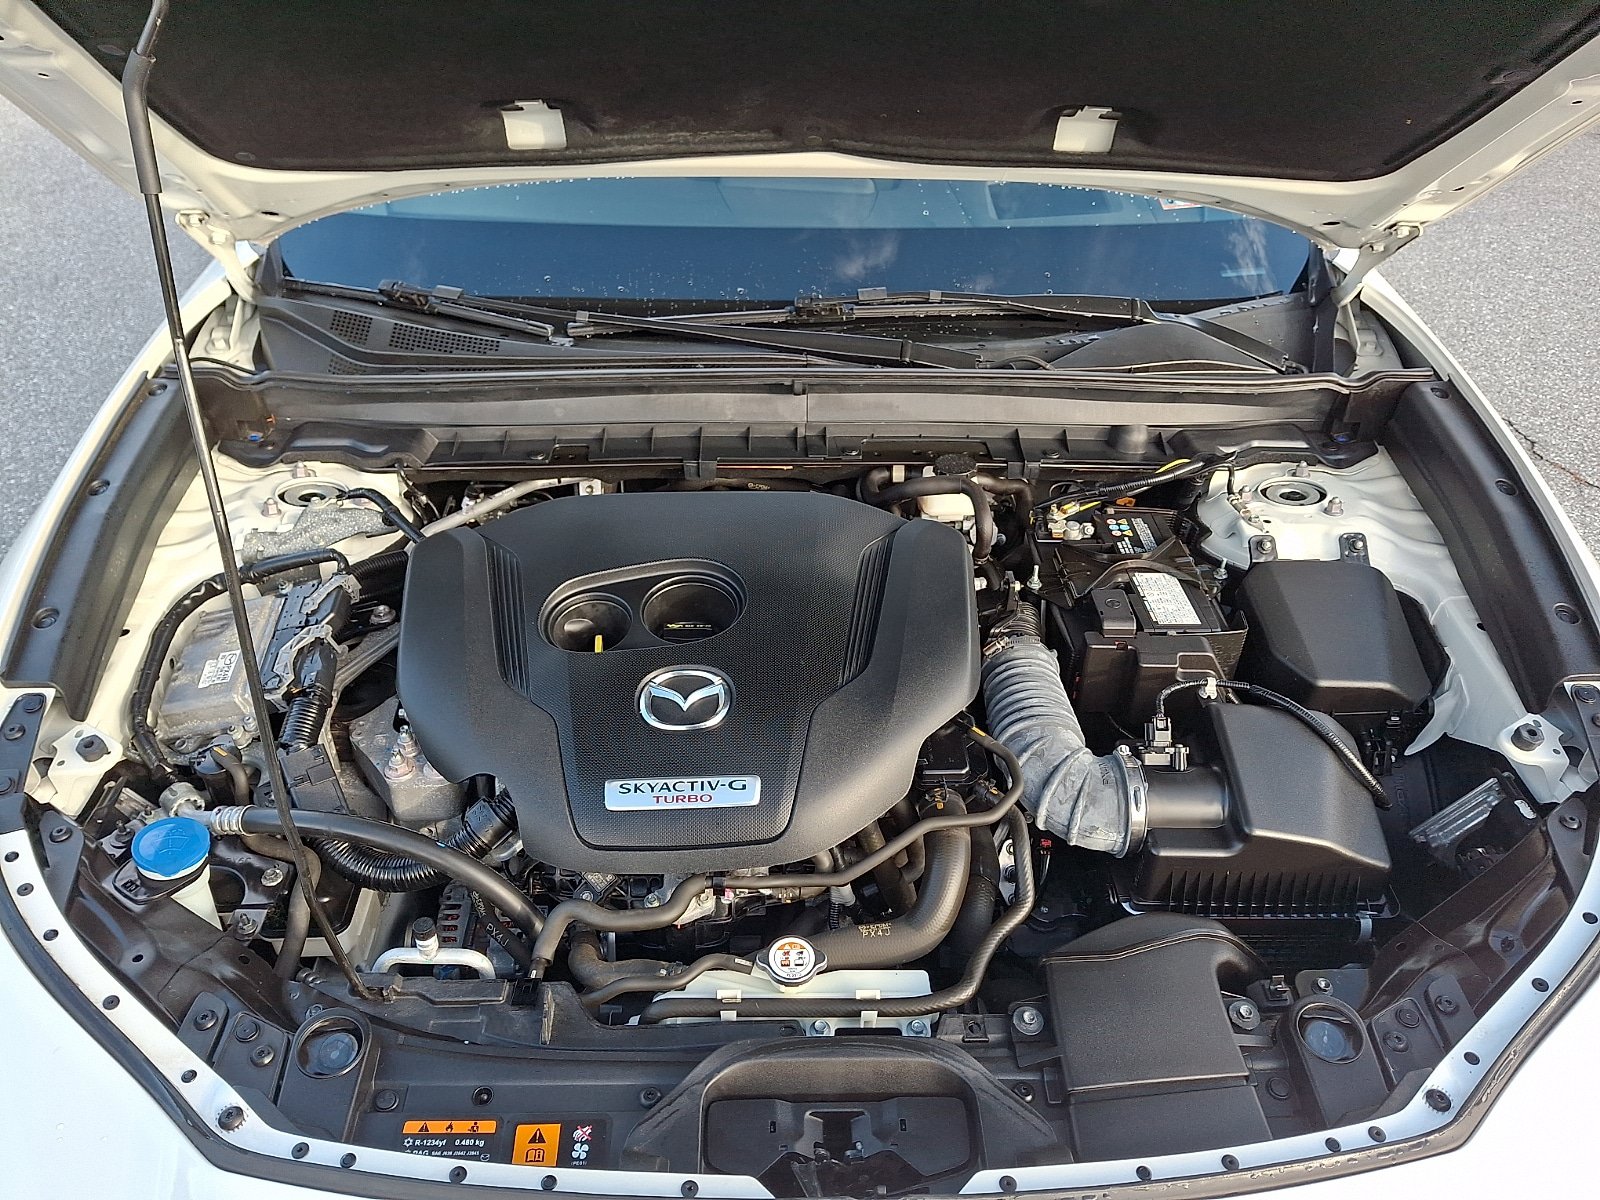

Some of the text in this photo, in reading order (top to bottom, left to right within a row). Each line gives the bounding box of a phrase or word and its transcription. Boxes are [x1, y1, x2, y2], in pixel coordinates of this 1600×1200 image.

[618, 779, 747, 795] SKYACTIV-G
[653, 794, 713, 804] TURBO
[862, 929, 891, 939] PX4J
[414, 1139, 447, 1147] R-1234yf
[475, 1139, 485, 1147] kg
